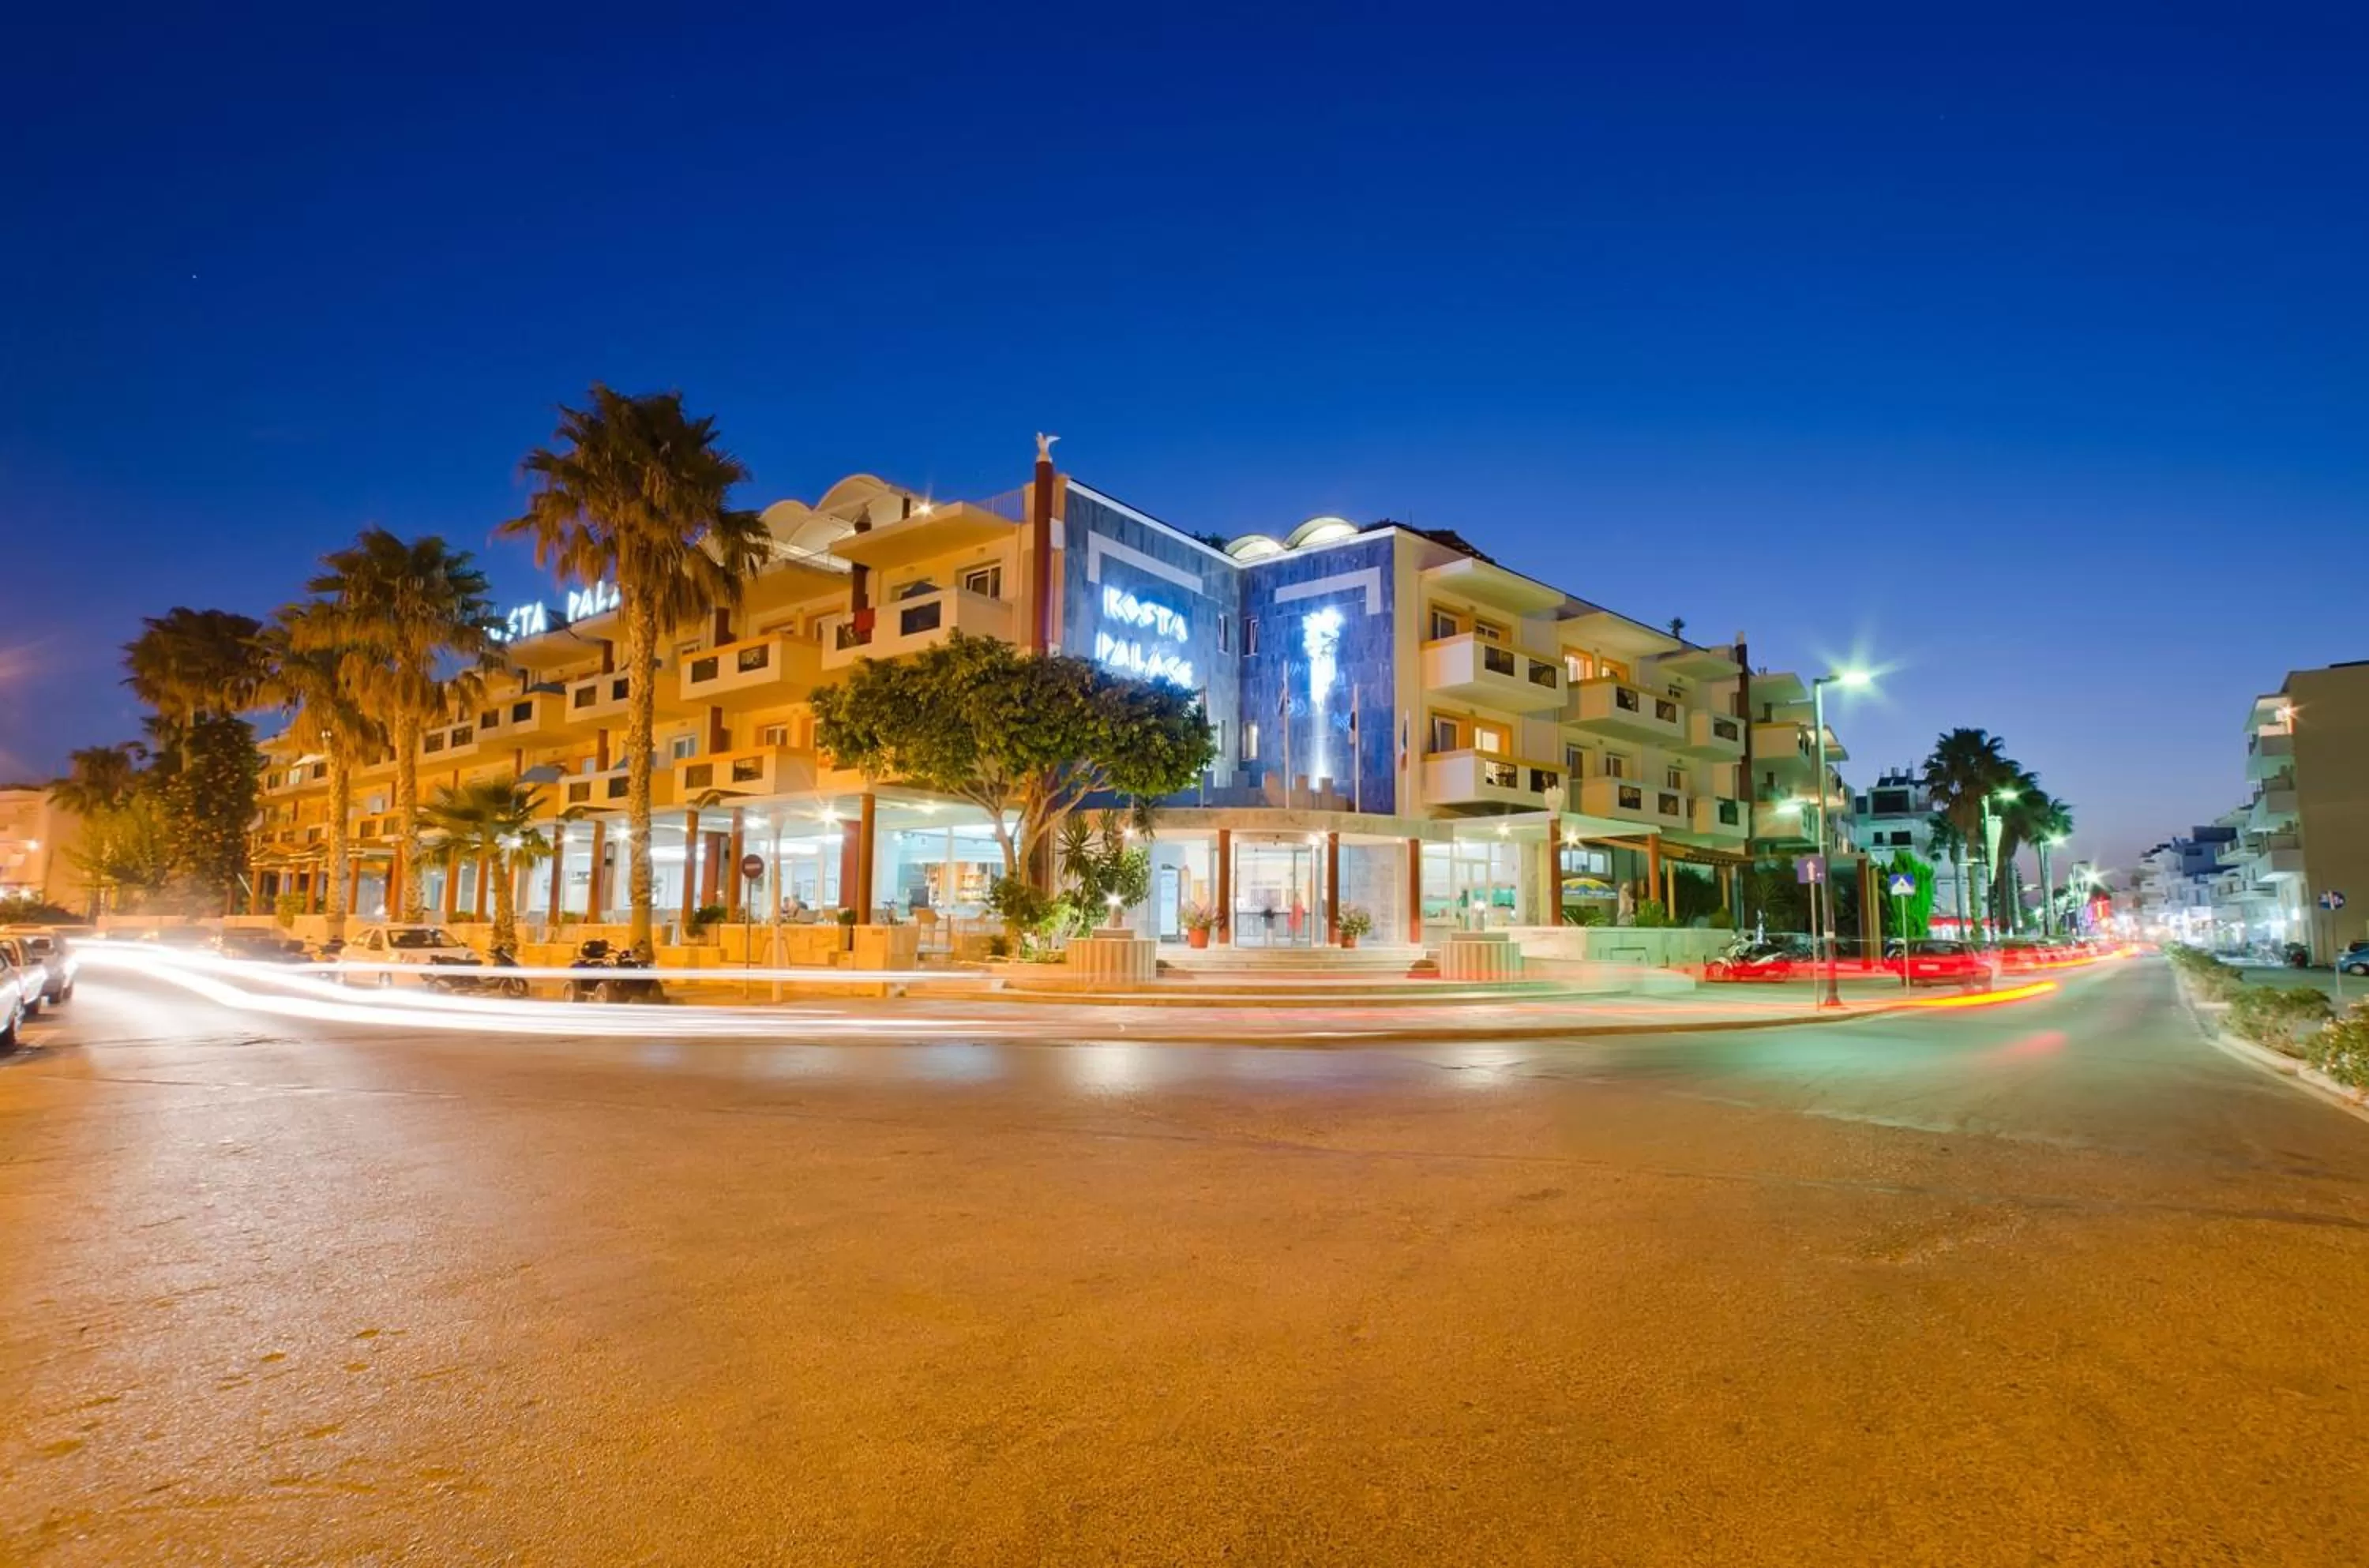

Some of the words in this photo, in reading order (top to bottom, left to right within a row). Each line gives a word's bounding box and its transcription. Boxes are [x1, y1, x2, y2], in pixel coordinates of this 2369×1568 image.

[483, 601, 546, 642] STA
[568, 580, 621, 623] PALA
[1103, 584, 1188, 643] KOSTA
[1094, 632, 1193, 688] PALACE
